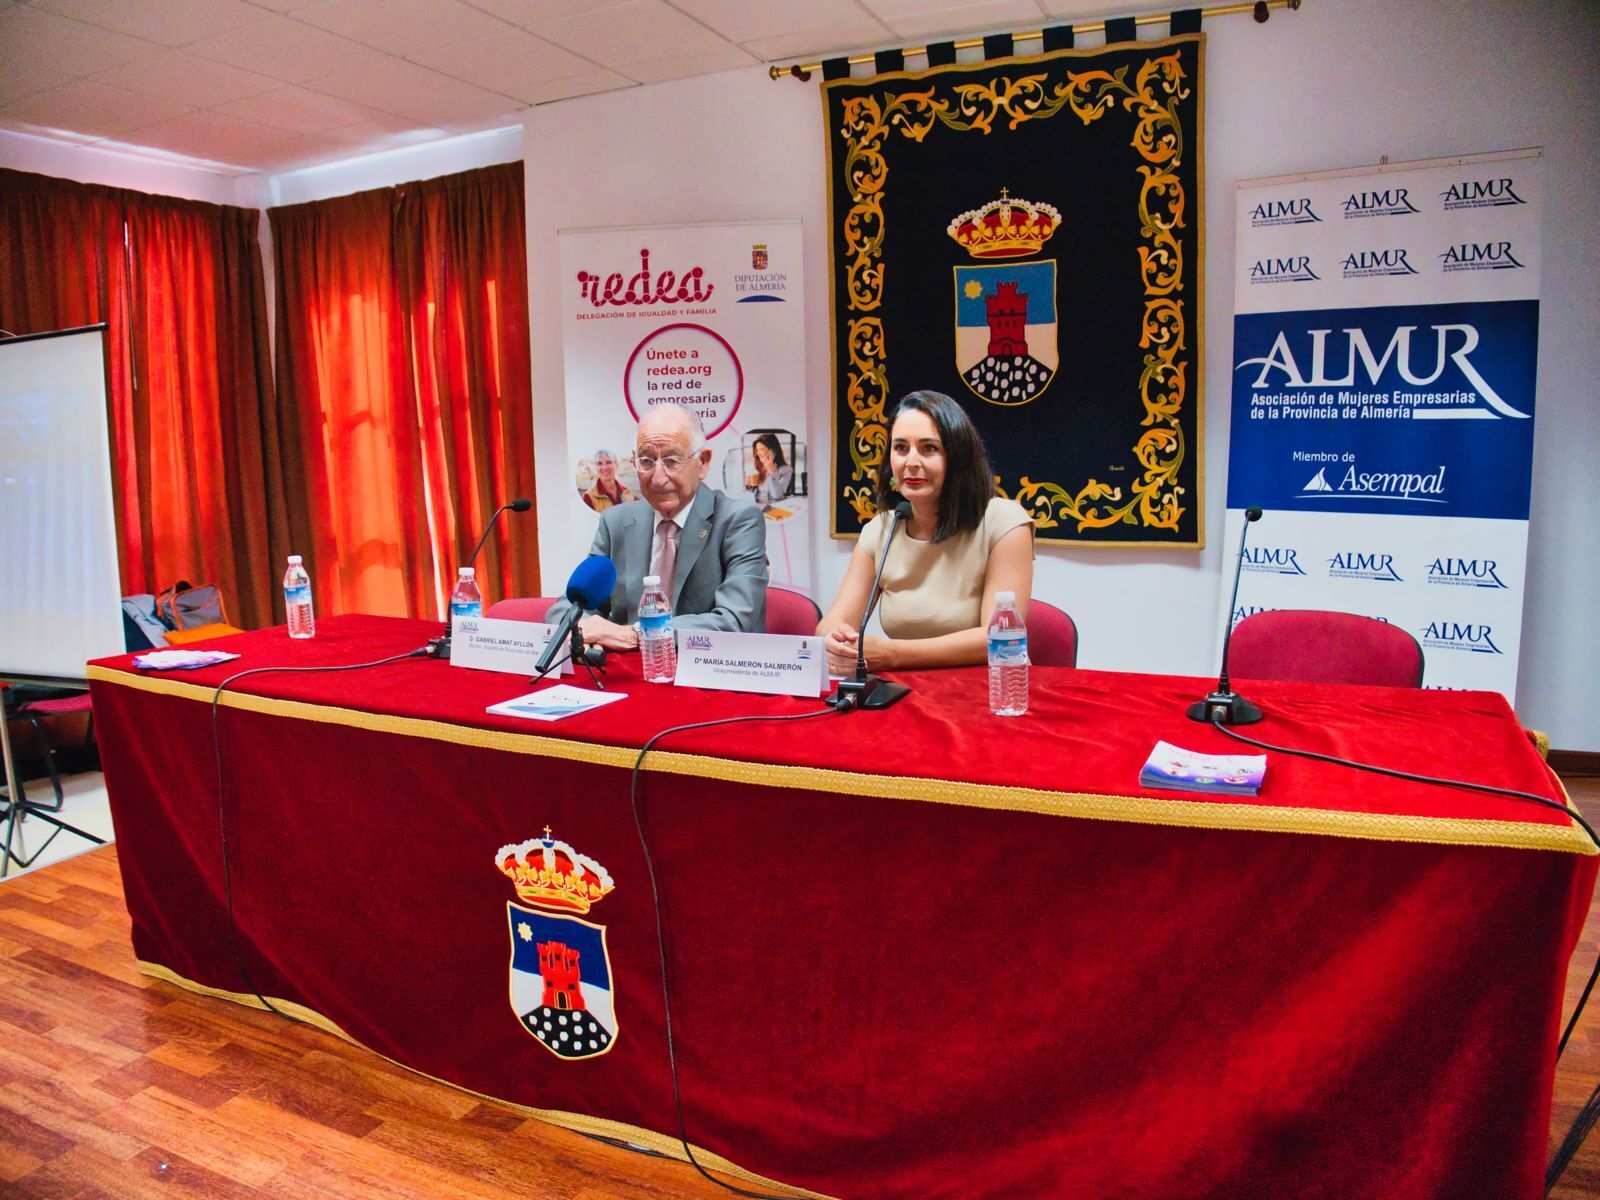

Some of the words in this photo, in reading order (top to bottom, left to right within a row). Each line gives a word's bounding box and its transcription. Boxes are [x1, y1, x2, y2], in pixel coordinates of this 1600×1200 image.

[1340, 188, 1421, 213] ALMUR
[1440, 178, 1528, 204] ALMUR
[1248, 198, 1323, 221] ALMUR
[1339, 249, 1420, 274] ALMUR
[1438, 242, 1526, 268] ALMUR
[577, 249, 714, 307] redea
[734, 274, 787, 283] DIPUTACIÓN
[1247, 256, 1322, 280] ALMUR
[735, 283, 744, 291] DE
[748, 282, 786, 291] ALMERÍA
[576, 312, 624, 320] DELEGACIÓN
[646, 347, 687, 360] Únete
[691, 350, 699, 358] a
[647, 364, 712, 376] redea.org
[1235, 324, 1531, 419] ALMUR
[647, 381, 658, 391] la
[661, 379, 682, 390] red
[686, 379, 702, 389] de
[1251, 392, 1315, 406] Asociación
[1319, 392, 1334, 405] de
[1338, 391, 1389, 407] Mujeres
[1393, 391, 1475, 406] Empresarias
[1250, 406, 1264, 419] de
[1268, 406, 1278, 419] la
[1282, 406, 1338, 419] Provincia
[1342, 406, 1357, 419] de
[1361, 405, 1410, 419] Almería
[1293, 451, 1338, 462] Miembro
[1342, 452, 1355, 462] de
[1338, 465, 1446, 498] Asempal
[1236, 547, 1307, 575] ALMUR
[1326, 552, 1404, 581] ALMUR
[1424, 558, 1509, 589] ALMUR
[476, 636, 497, 644] GABRIEL
[513, 640, 534, 648] AYLLÓN
[1418, 622, 1504, 654] ALMUR
[713, 667, 751, 676] Vicepresidenta
[725, 659, 762, 668] SALMERÓN
[763, 661, 802, 671] SALMERÓN
